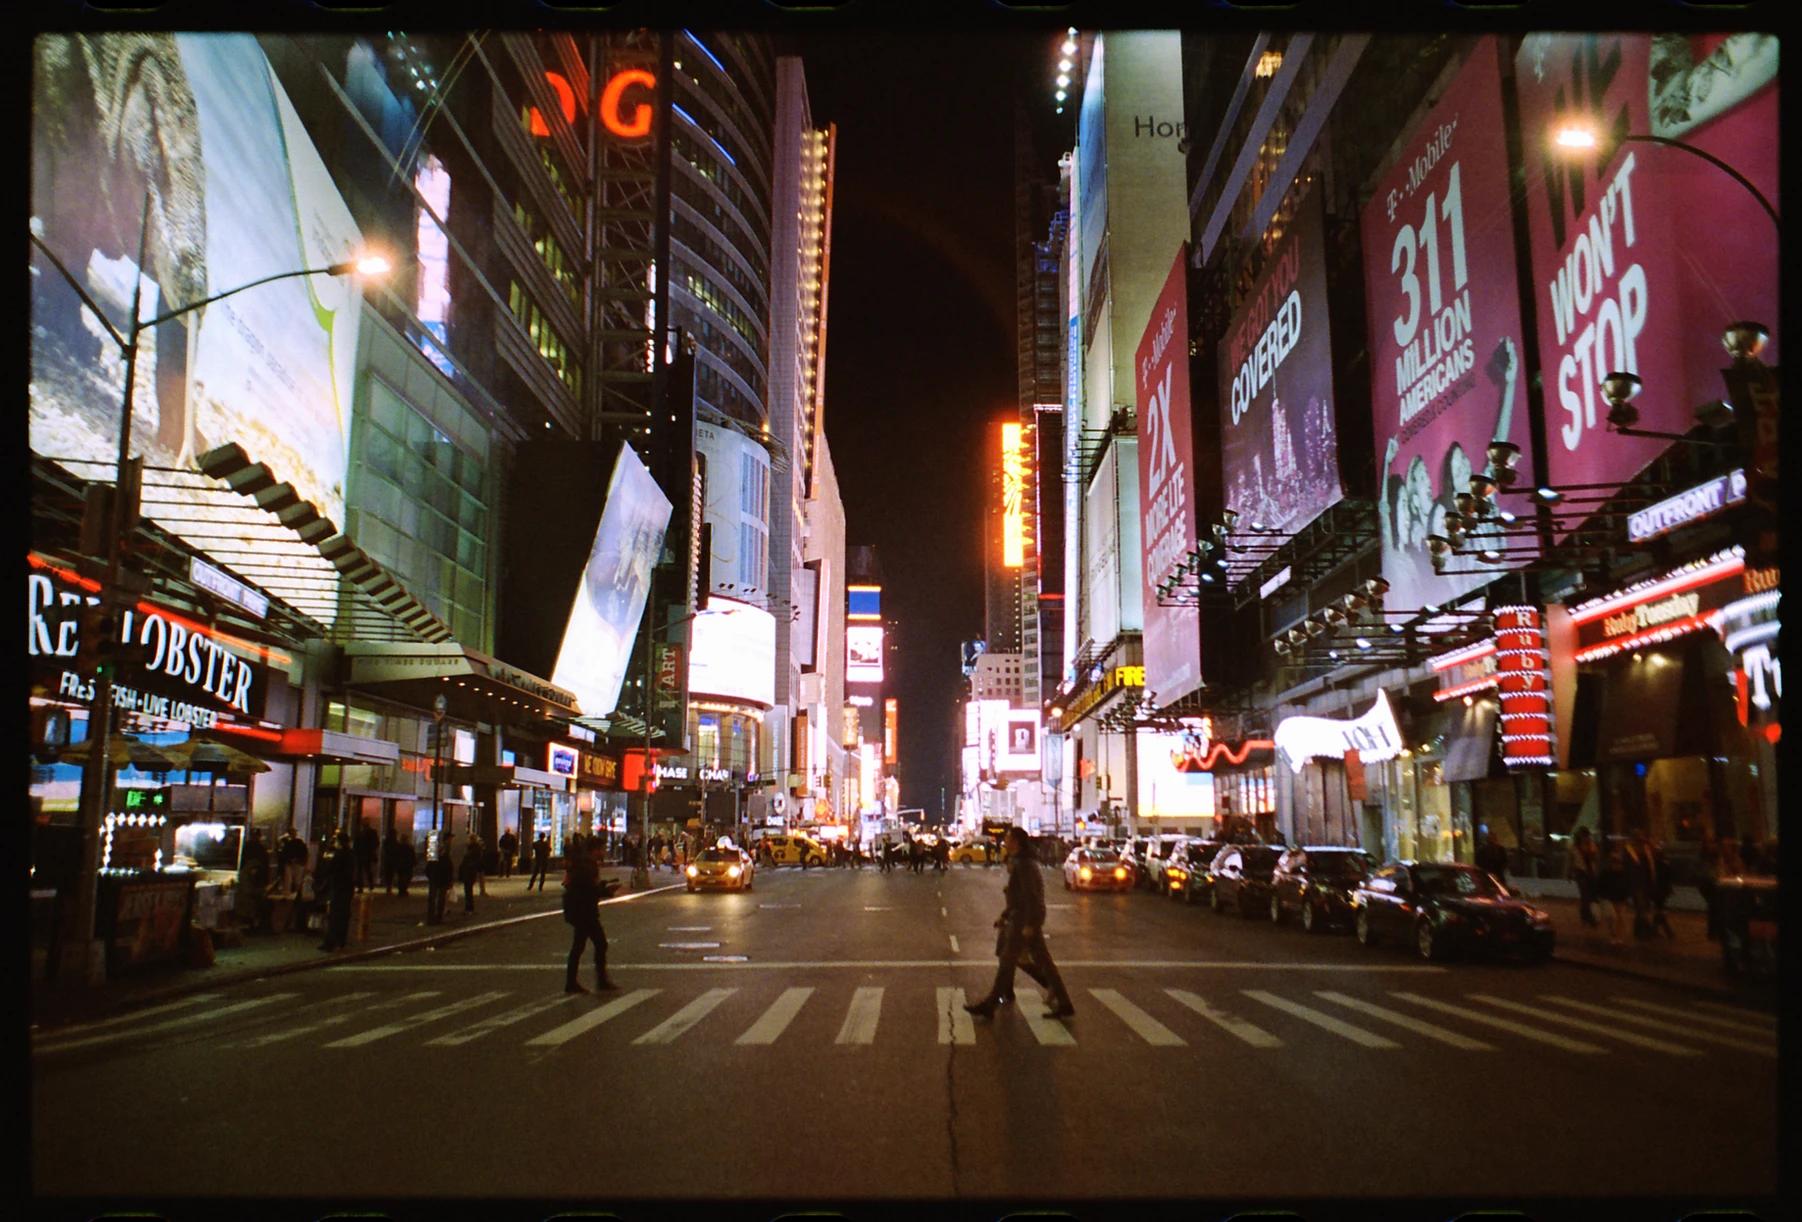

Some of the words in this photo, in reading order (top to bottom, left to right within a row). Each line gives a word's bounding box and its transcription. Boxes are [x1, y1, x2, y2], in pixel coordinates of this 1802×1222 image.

[1271, 233, 1299, 308] YOU
[1391, 160, 1468, 347] 311
[1550, 151, 1636, 346] WON'T
[1231, 289, 1302, 427] COVERED
[1395, 288, 1473, 397] MILLION
[1399, 338, 1475, 427] AMERICANS
[1558, 263, 1648, 451] STOP
[1147, 360, 1176, 501] 2X
[1168, 461, 1185, 519] LTE
[1630, 482, 1722, 538] OUTFRONT
[28, 574, 101, 656] RE
[1516, 611, 1535, 690] Ruby
[143, 693, 169, 719] LIVE
[171, 701, 218, 729] LOBSTER
